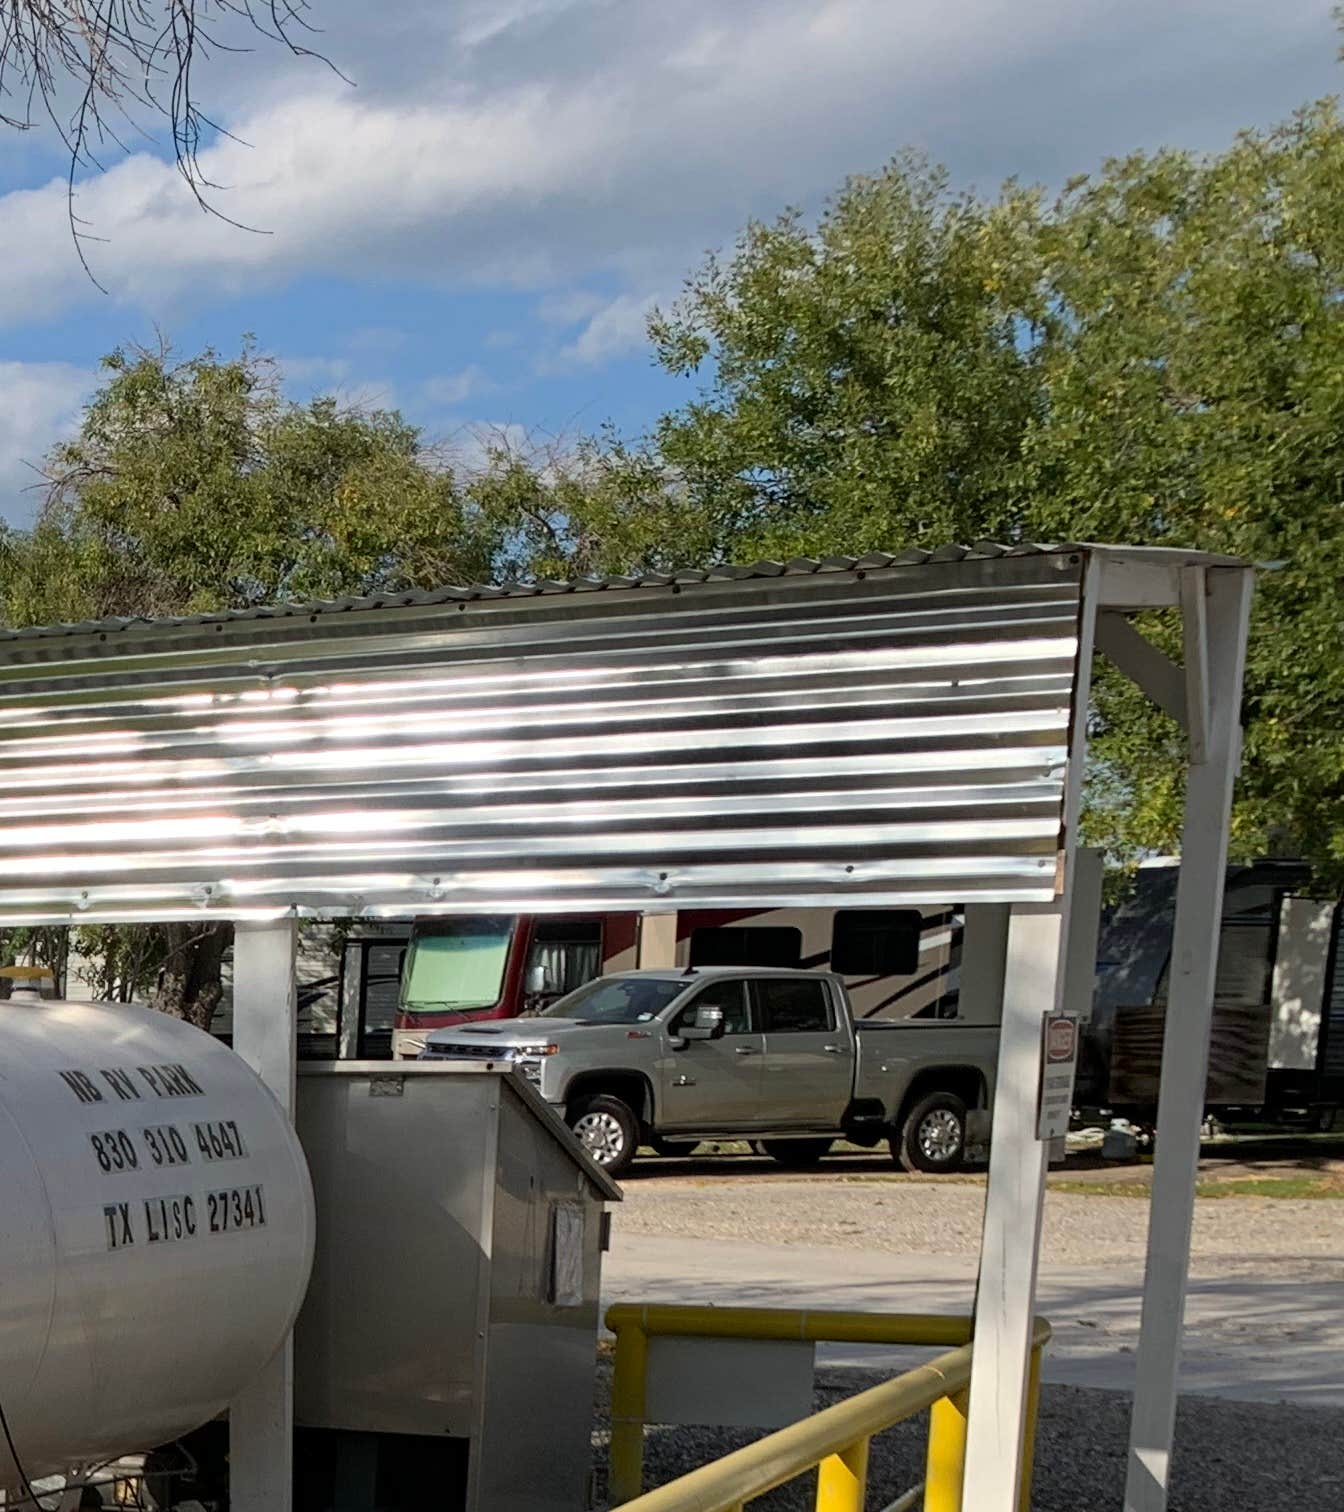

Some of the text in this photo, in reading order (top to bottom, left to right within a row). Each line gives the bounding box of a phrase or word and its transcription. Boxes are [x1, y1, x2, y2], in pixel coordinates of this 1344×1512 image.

[59, 1064, 205, 1103] NB RV PARK
[90, 1120, 244, 1172] 830 310 4647
[103, 1202, 134, 1247] TX
[208, 1187, 265, 1232] 27341
